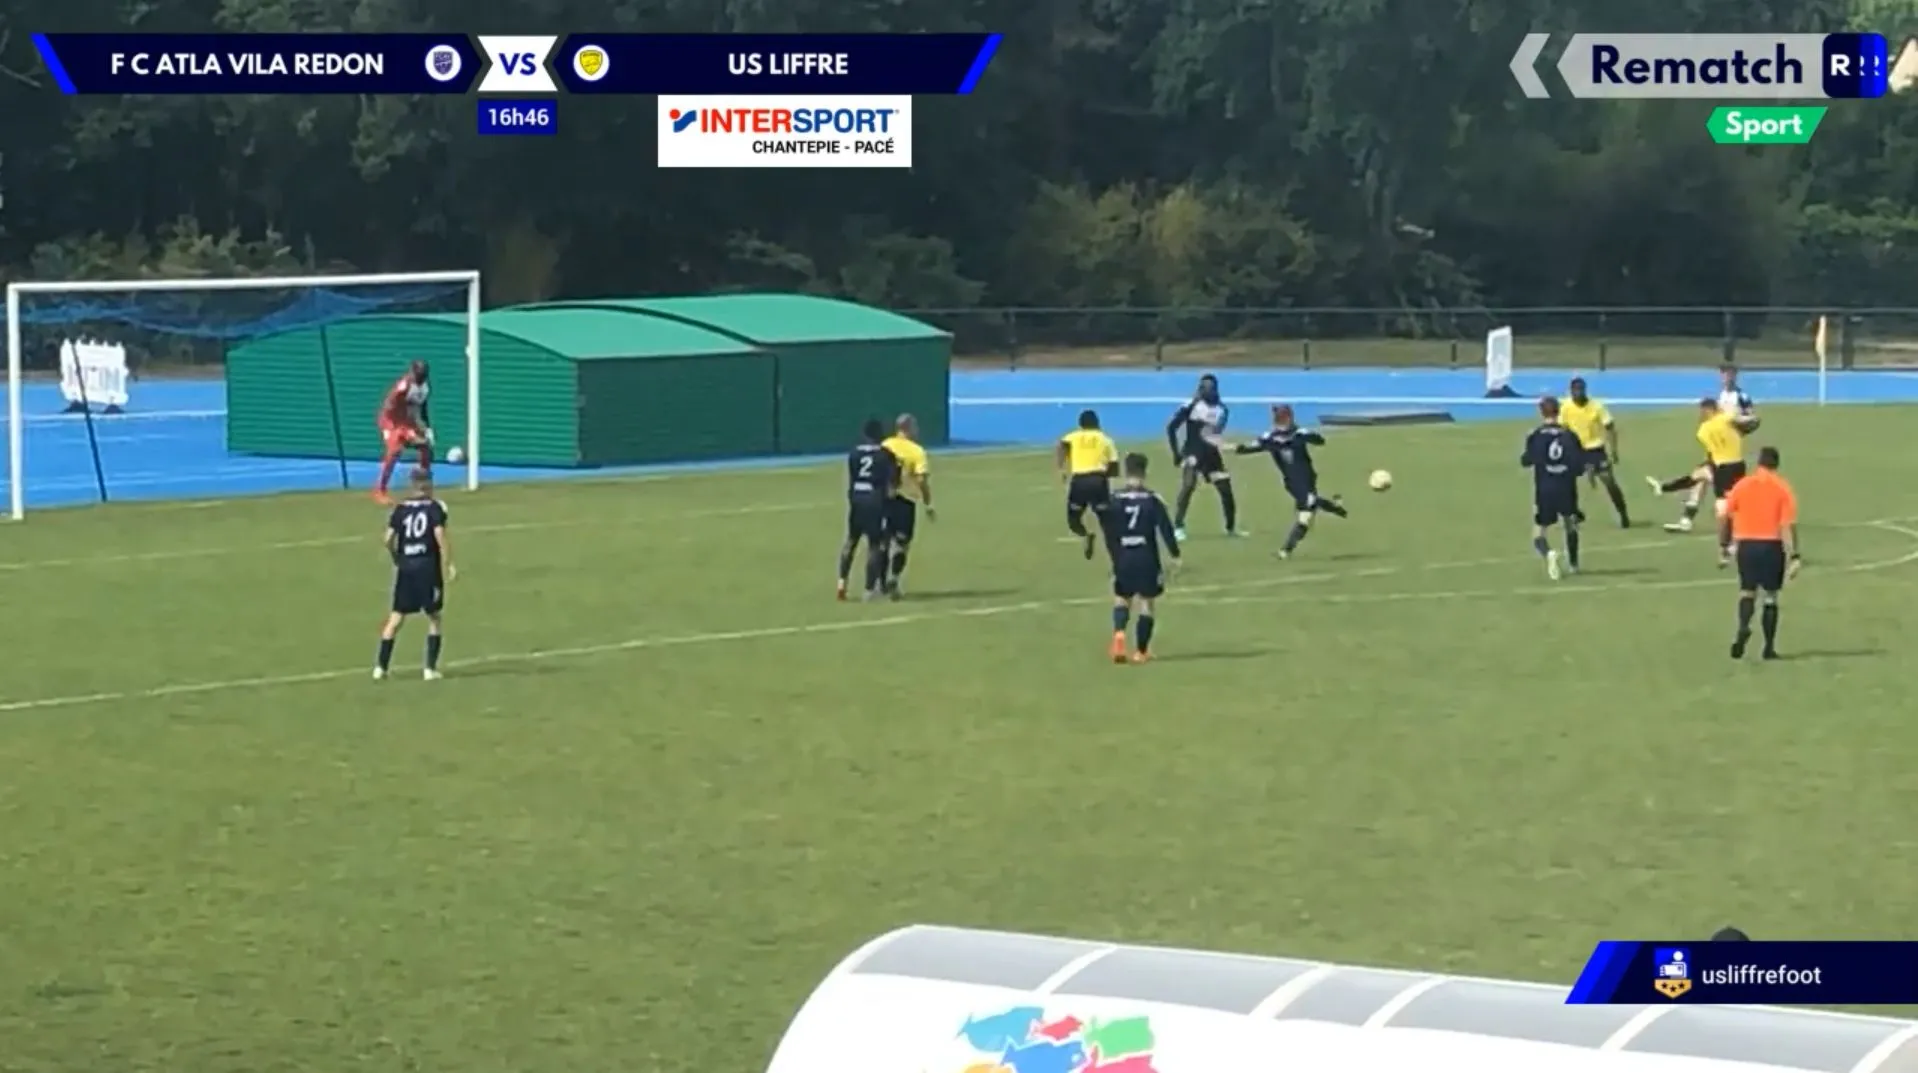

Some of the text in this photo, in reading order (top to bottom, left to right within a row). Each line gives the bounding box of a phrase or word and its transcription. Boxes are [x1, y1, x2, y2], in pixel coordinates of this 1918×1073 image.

[1548, 438, 1563, 460] 6
[858, 456, 874, 478] 2
[402, 511, 428, 538] 10
[1124, 504, 1141, 530] 7
